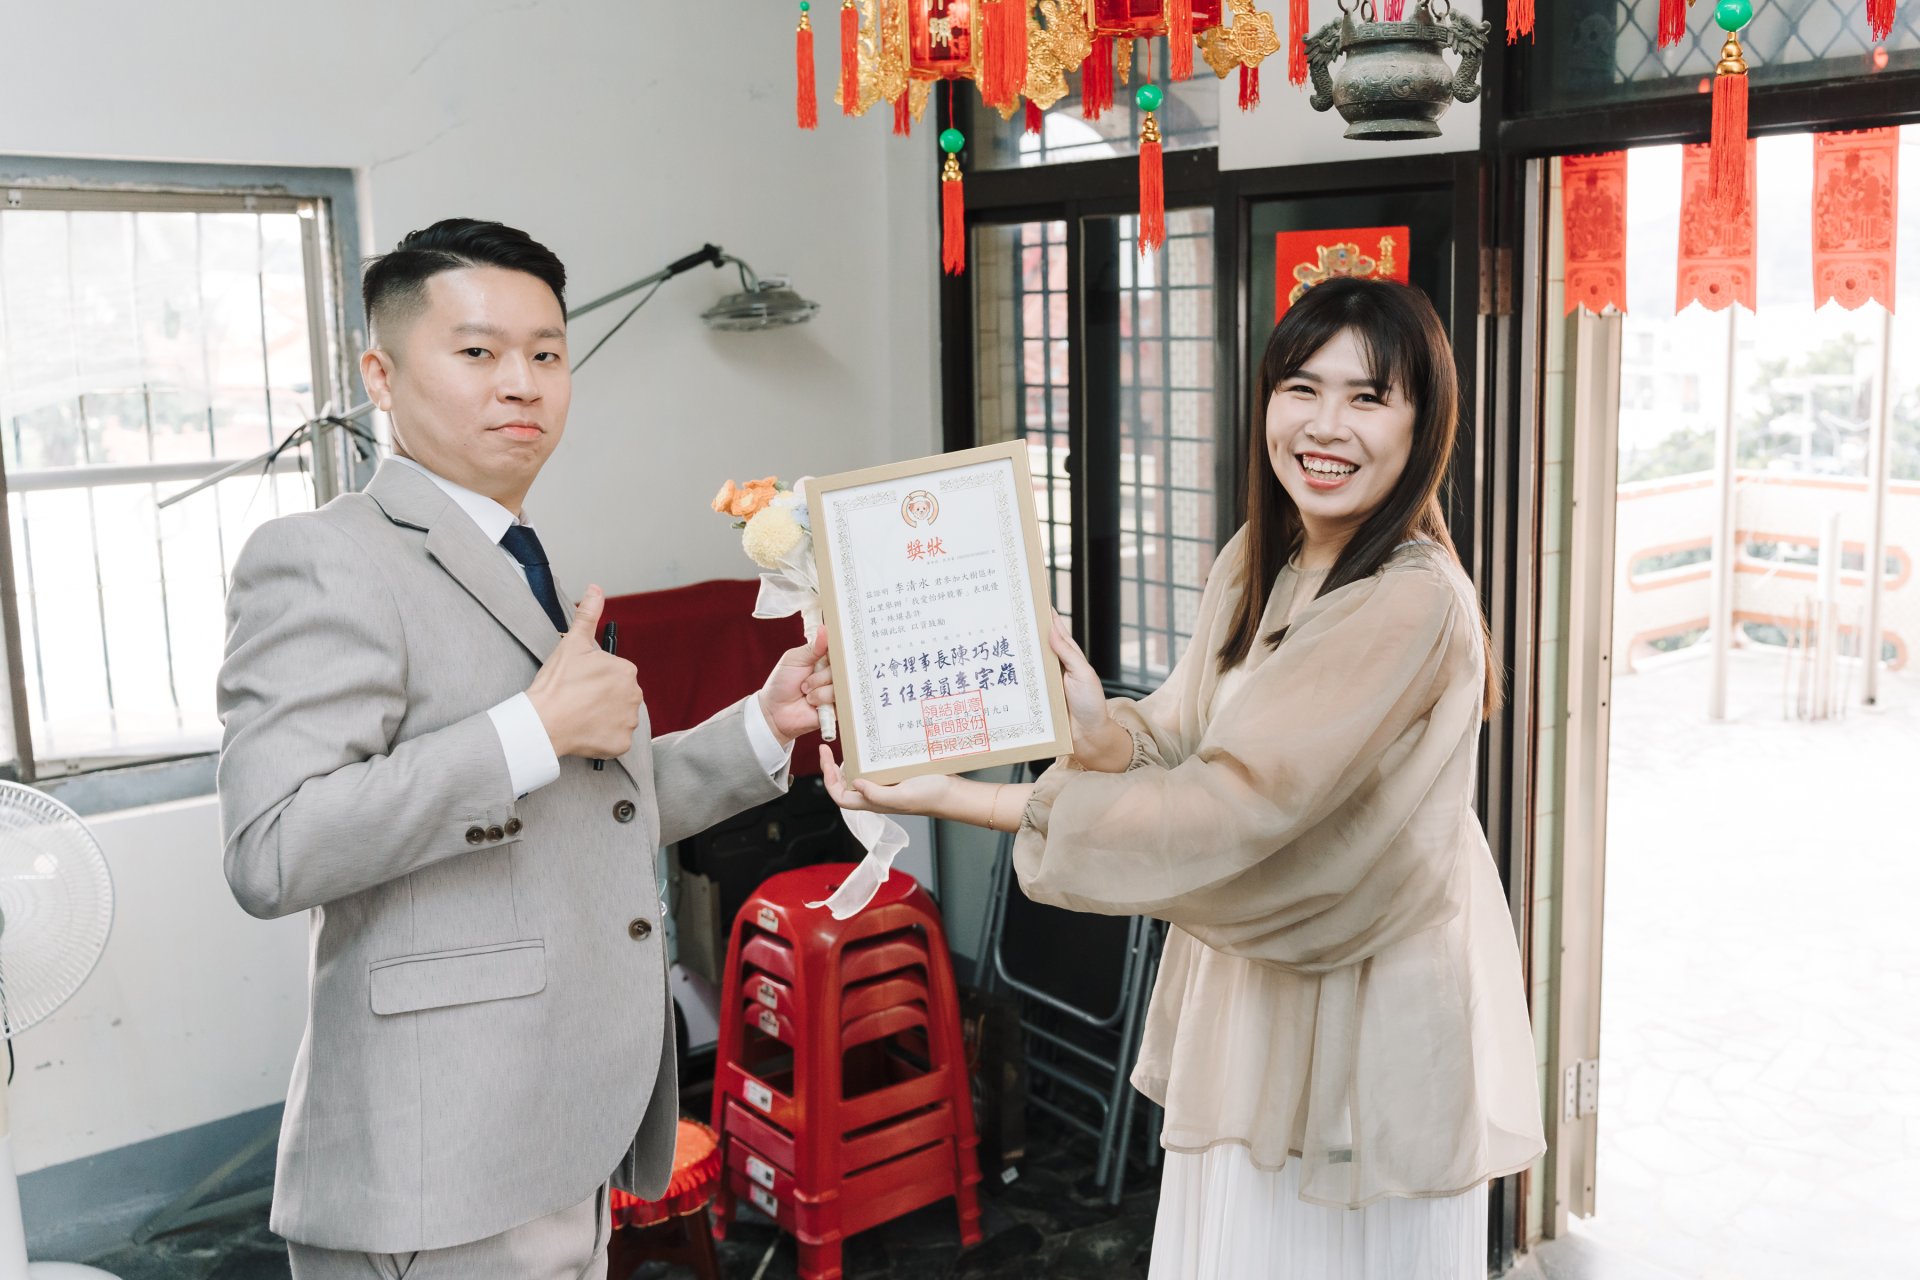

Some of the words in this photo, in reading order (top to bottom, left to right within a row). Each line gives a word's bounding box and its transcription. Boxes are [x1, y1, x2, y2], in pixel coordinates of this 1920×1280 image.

[906, 536, 947, 562] 獎狀
[895, 577, 930, 594] 李清水
[924, 696, 983, 719] 領結創意
[926, 714, 985, 738] 顧問股份
[929, 732, 988, 756] 有限公司
